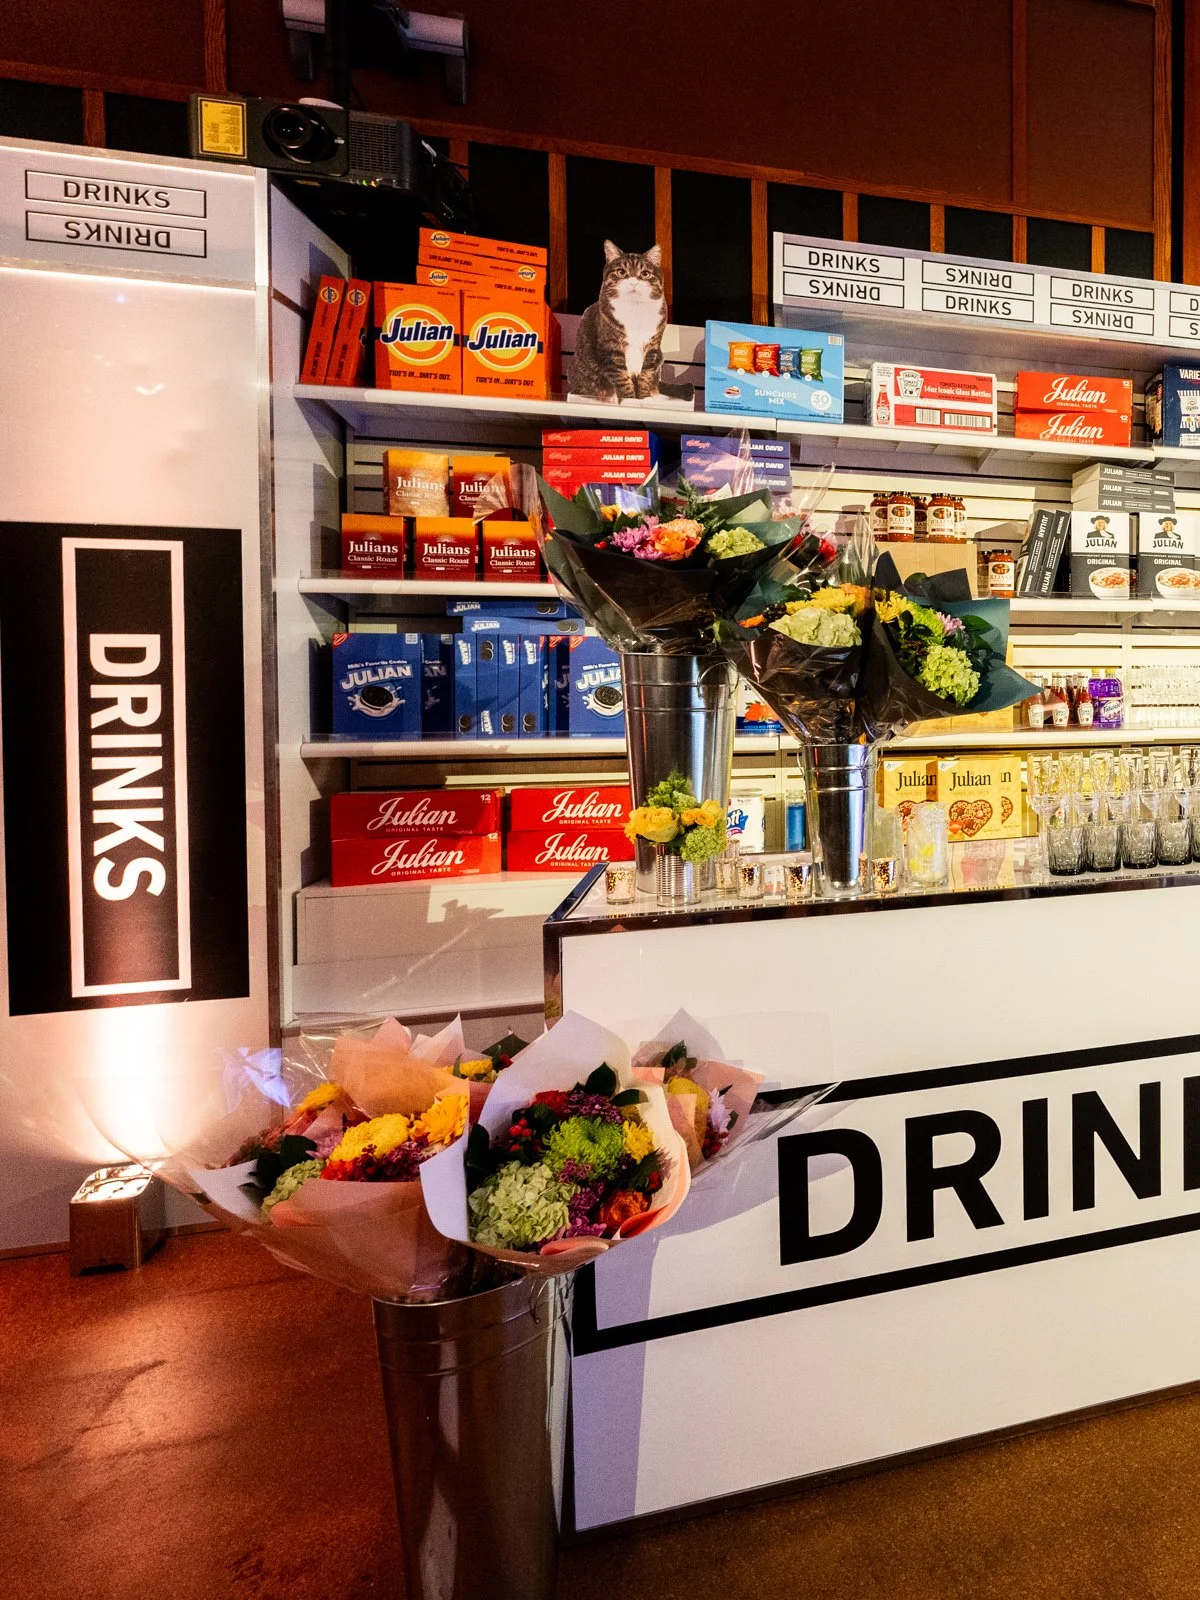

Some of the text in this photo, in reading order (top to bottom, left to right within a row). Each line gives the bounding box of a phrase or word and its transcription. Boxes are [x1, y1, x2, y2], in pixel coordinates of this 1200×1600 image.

[63, 180, 170, 208] DRINKS
[64, 221, 170, 248] DRINKS
[808, 250, 880, 273] DRINKS
[946, 267, 1012, 289] DRINKS
[809, 279, 880, 301] DRINKS
[1072, 283, 1134, 304] DRINKS
[945, 295, 1012, 316] DRINKS
[1072, 309, 1134, 329] DRINKS
[381, 318, 453, 343] Julian
[468, 326, 537, 351] Julian
[971, 390, 992, 398] Bottles
[1043, 377, 1107, 403] Julian
[1040, 414, 1104, 440] Julian
[1103, 468, 1122, 476] JULIAN
[396, 476, 446, 490] Julians
[1102, 484, 1122, 492] JULIAN
[1038, 515, 1049, 538] JULIAN
[348, 541, 398, 554] Julians
[423, 543, 470, 555] Julians
[490, 546, 536, 557] Julians
[1085, 539, 1117, 548] JULIAN
[1152, 540, 1184, 549] JULIAN
[1041, 571, 1051, 592] JULIAN
[454, 604, 480, 612] JULIAN
[471, 622, 500, 632] JULIAN
[341, 665, 412, 689] JULIAN
[89, 633, 167, 901] DRINKS
[896, 771, 936, 791] Julian
[950, 771, 992, 791] Julian
[367, 798, 458, 830] Julian
[542, 791, 624, 822] Julian
[371, 839, 465, 876] Julian
[535, 833, 610, 864] Julian
